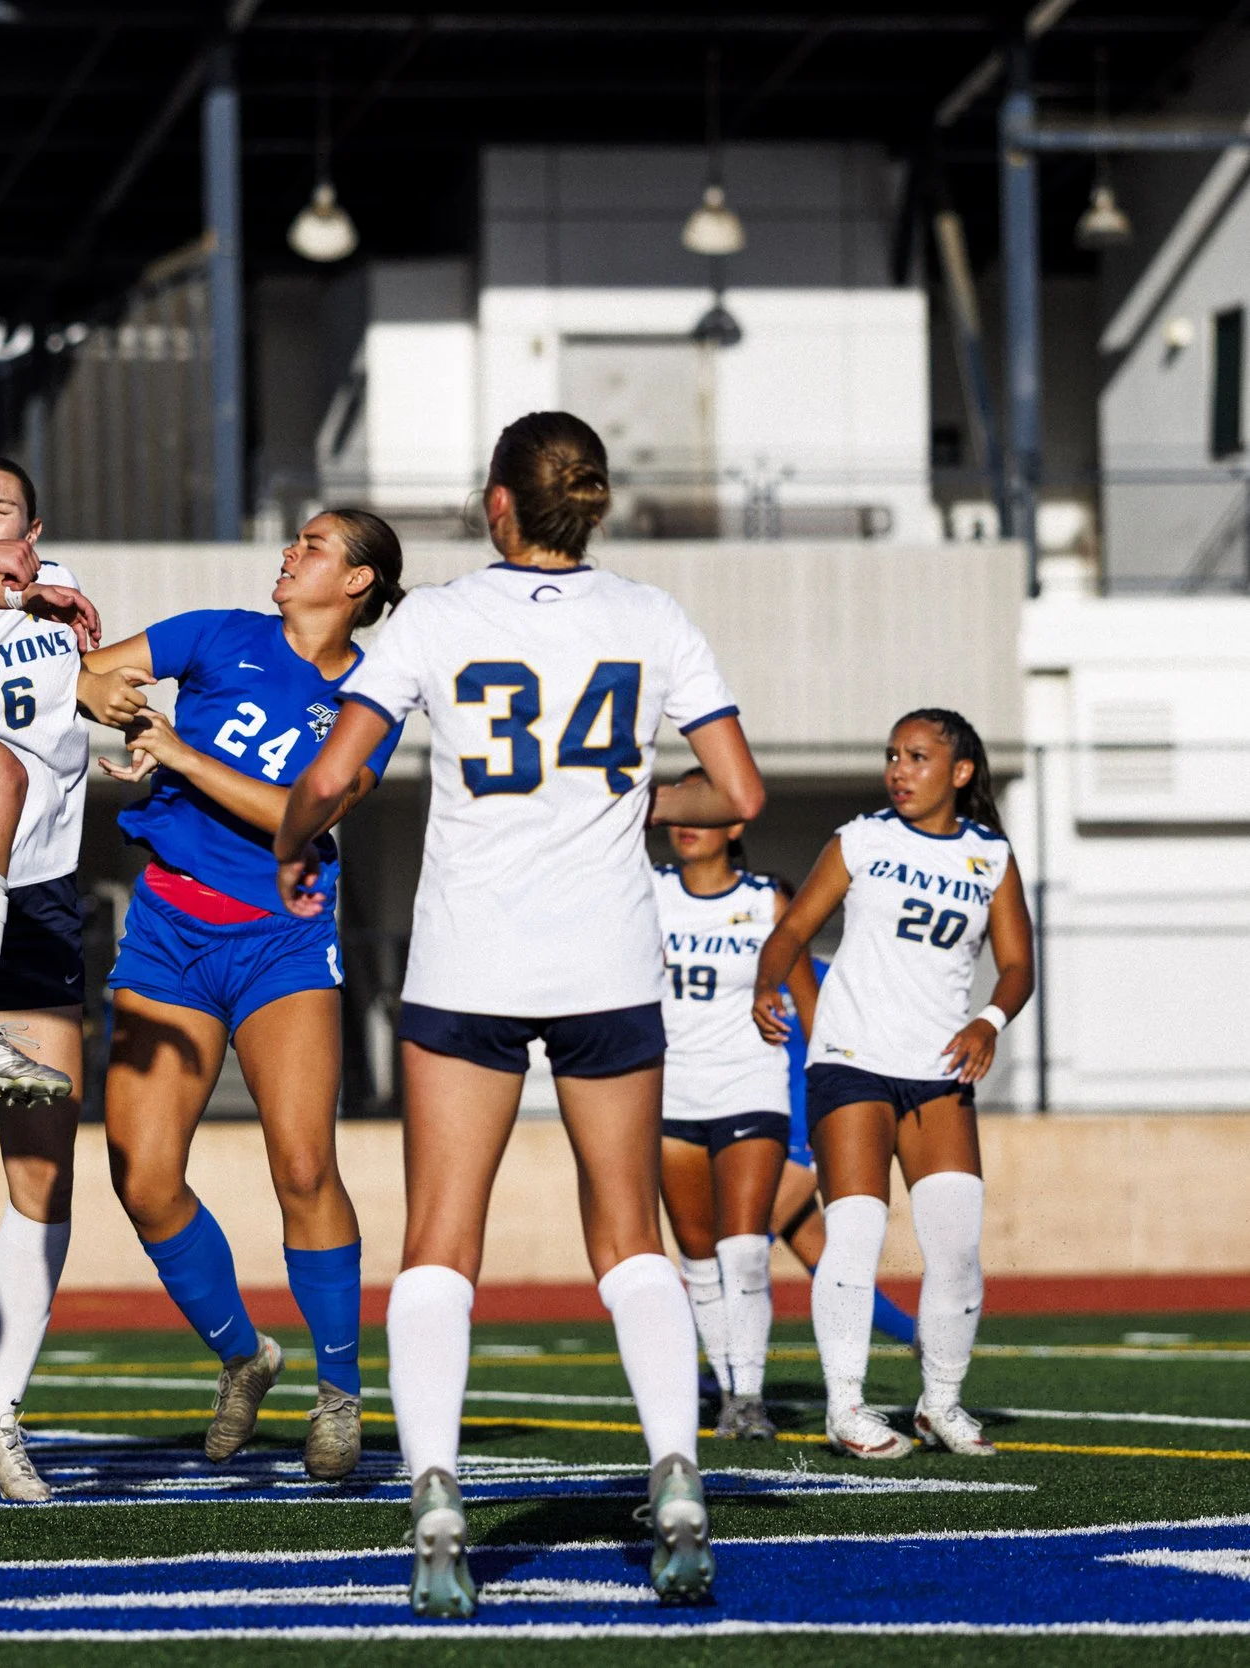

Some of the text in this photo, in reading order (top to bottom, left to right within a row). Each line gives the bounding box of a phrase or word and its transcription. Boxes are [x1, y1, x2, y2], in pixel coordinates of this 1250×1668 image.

[1, 676, 36, 730] 6
[454, 659, 644, 799] 34
[213, 701, 301, 781] 24
[665, 932, 760, 955] NYONS
[896, 897, 969, 950] 20
[665, 964, 717, 1001] 19
